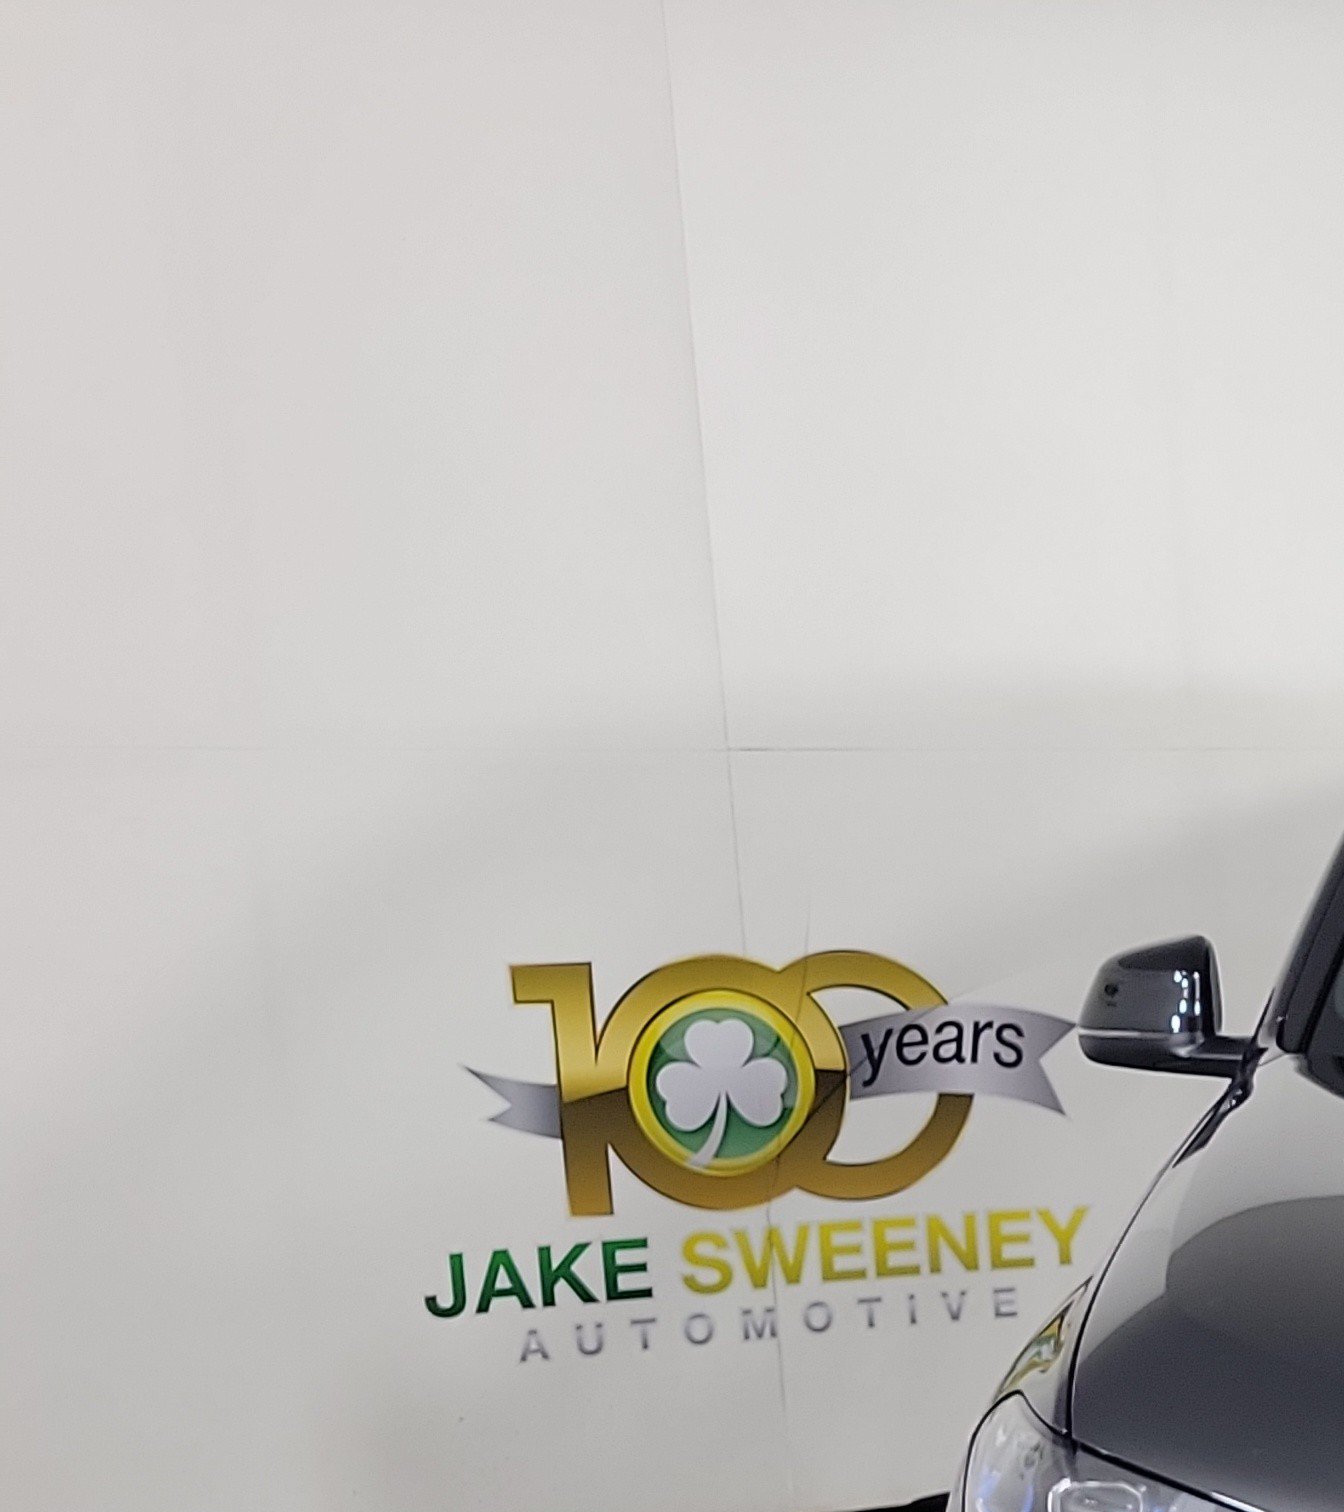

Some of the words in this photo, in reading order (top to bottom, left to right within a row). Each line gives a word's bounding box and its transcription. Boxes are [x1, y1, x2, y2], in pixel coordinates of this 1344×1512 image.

[510, 949, 974, 1216] 100
[860, 1020, 1024, 1086] years
[424, 1237, 653, 1320] JAKE
[681, 1206, 1089, 1296] SWEENEY
[519, 1287, 1019, 1364] AUTOMOTIVE
